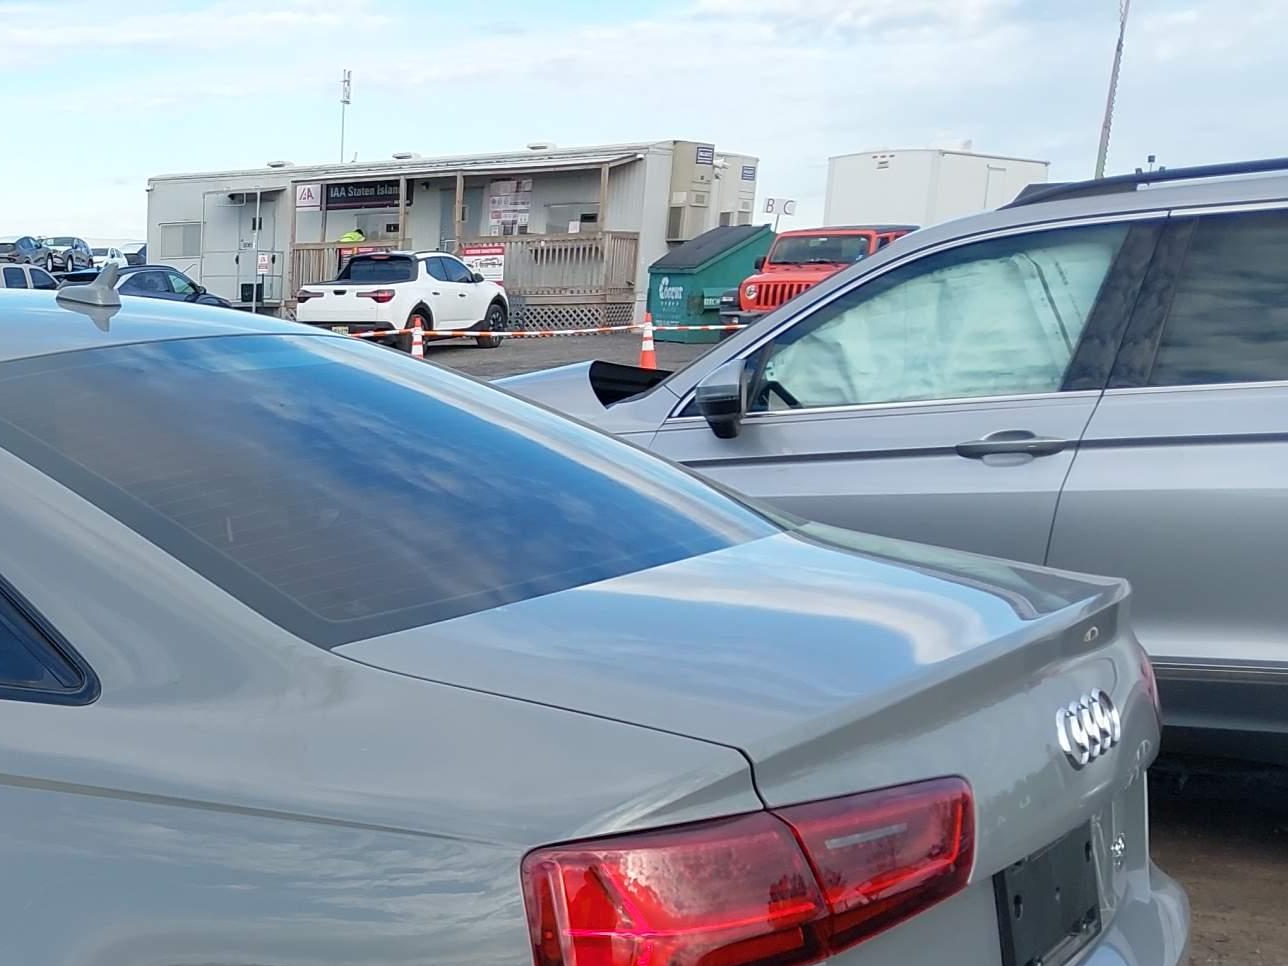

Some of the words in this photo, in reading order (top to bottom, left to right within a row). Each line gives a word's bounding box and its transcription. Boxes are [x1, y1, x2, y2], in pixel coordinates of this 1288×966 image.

[330, 187, 346, 198] IAA
[348, 185, 375, 197] Staten
[377, 184, 401, 196] Islan
[765, 198, 775, 214] B
[783, 200, 795, 215] C
